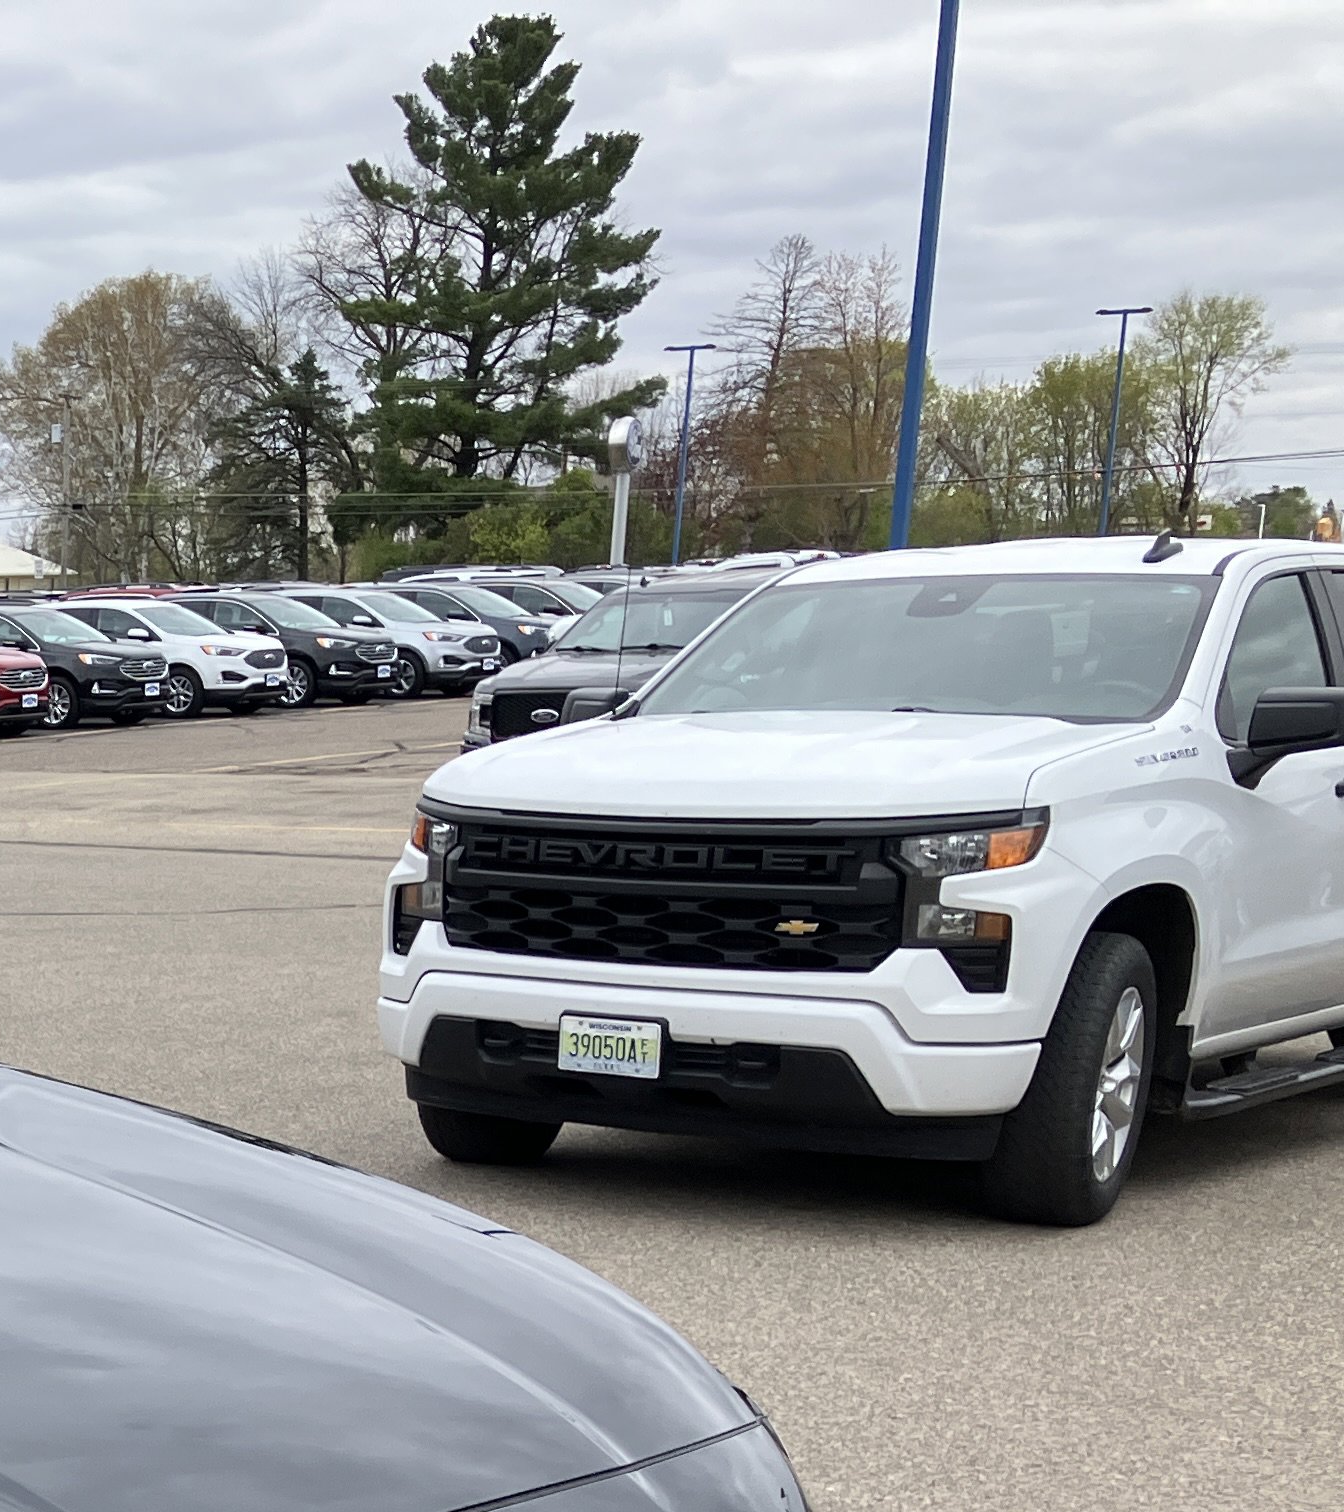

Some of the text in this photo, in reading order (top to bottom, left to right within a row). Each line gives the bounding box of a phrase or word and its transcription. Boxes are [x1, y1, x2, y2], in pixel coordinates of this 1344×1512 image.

[469, 836, 856, 876] CHEVROLET
[589, 1022, 632, 1032] WISCONSIN
[569, 1033, 637, 1063] 39050A
